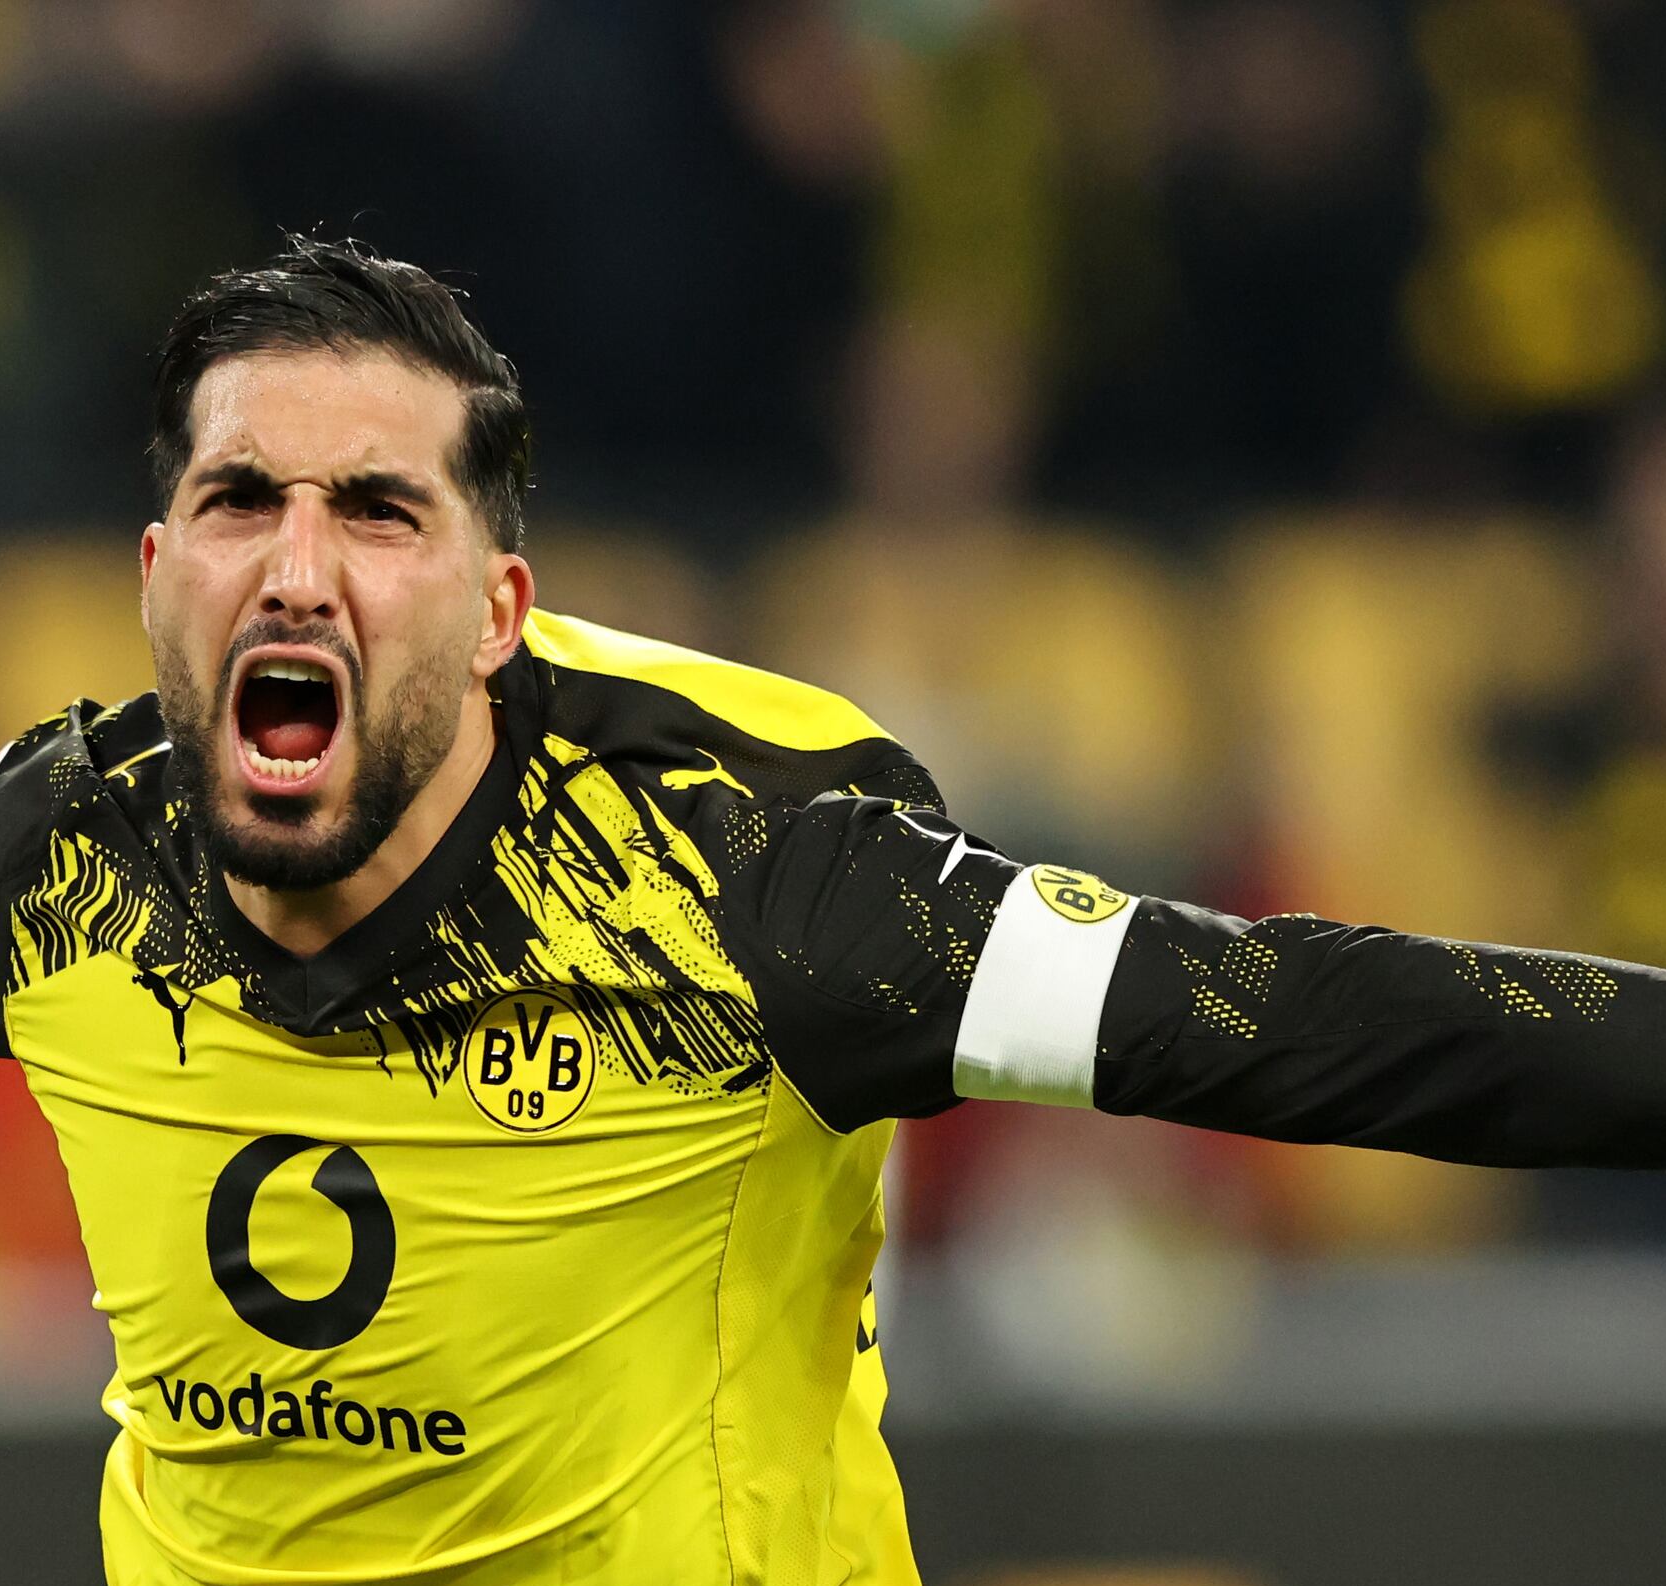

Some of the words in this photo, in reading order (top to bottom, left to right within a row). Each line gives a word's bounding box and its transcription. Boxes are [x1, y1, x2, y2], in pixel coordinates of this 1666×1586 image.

[1039, 867, 1096, 914] BV
[480, 1002, 583, 1092] BVB
[507, 1088, 545, 1120] 09
[153, 1372, 467, 1456] vodafone
